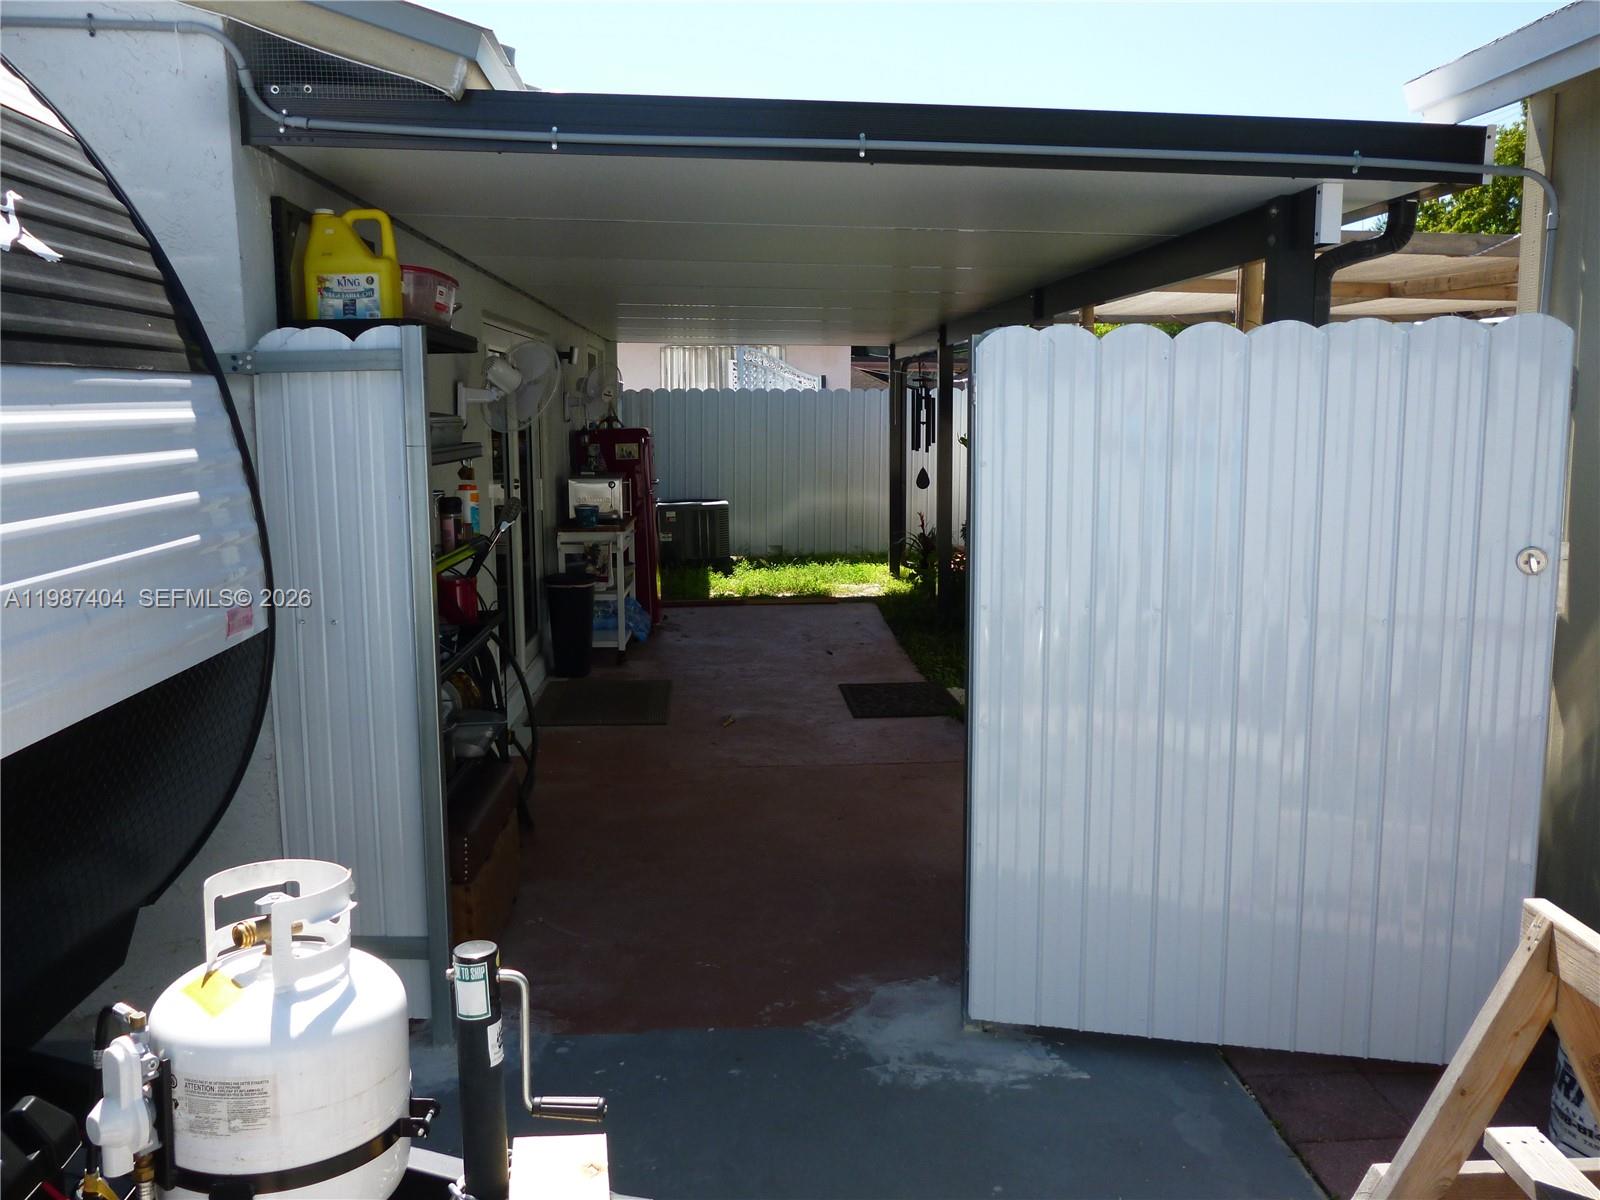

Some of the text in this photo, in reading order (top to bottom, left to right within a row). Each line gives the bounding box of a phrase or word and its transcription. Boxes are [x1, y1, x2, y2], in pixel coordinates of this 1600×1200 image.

[337, 276, 360, 287] KING
[461, 967, 470, 980] TO
[184, 1082, 215, 1092] ATTENTION
